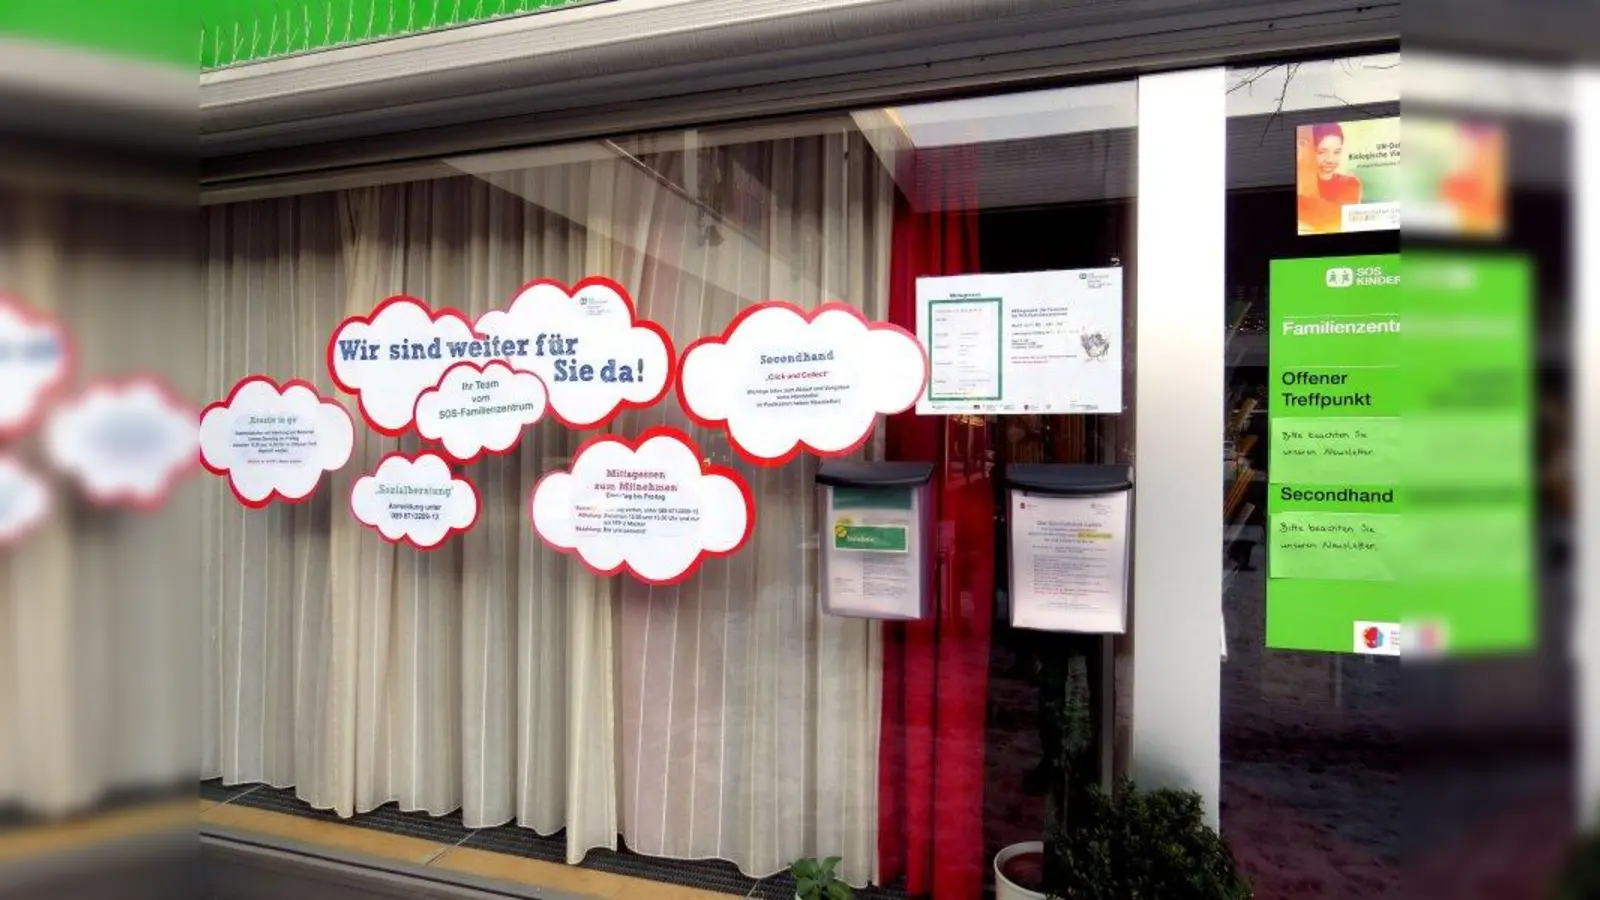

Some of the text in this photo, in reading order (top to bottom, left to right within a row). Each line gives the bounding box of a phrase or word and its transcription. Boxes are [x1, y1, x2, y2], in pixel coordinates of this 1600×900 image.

[1348, 151, 1388, 161] Biologische
[1356, 267, 1382, 276] SOS
[340, 333, 579, 360] Wir sind weiter für
[760, 350, 834, 364] Secondhand
[553, 358, 644, 384] Sie da!
[462, 380, 499, 390] Ihr Team
[1282, 371, 1348, 386] Offener
[1282, 393, 1371, 408] Treffpunkt
[438, 402, 534, 419] SOS-Familienzentrum
[605, 469, 666, 480] Mittagessen
[619, 481, 678, 492] Mitnehmen
[1281, 487, 1394, 503] Secondhand
